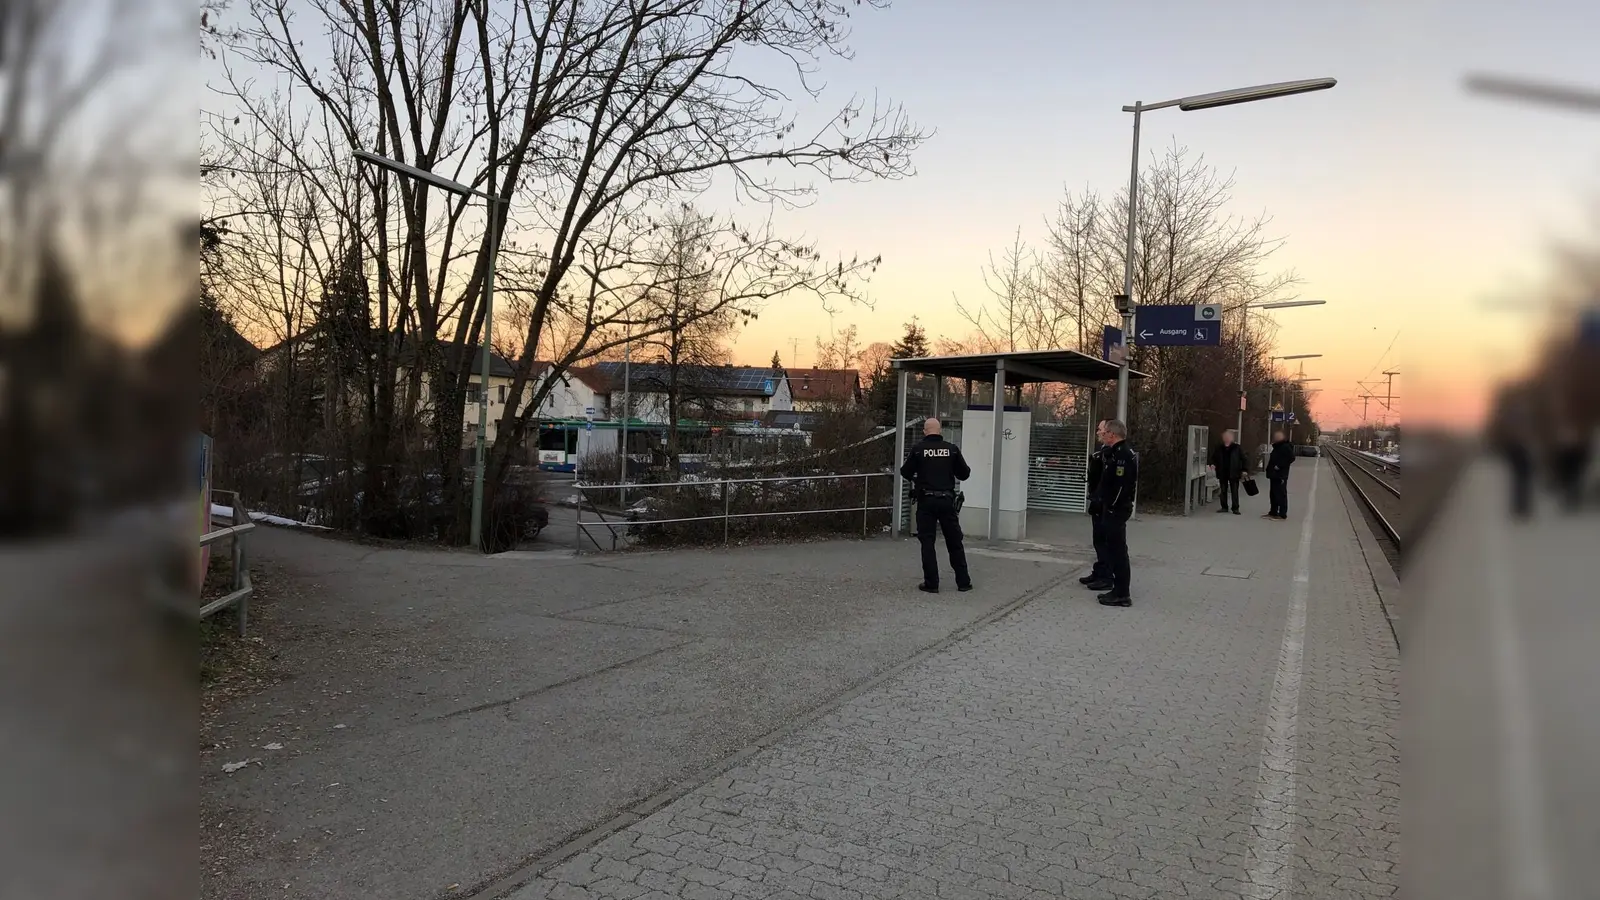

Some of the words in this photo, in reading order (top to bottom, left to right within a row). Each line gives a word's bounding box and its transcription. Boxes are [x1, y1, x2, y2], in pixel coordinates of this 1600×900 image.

[1159, 328, 1187, 336] Ausgang
[1288, 412, 1295, 420] 2
[923, 448, 950, 457] POLIZEI
